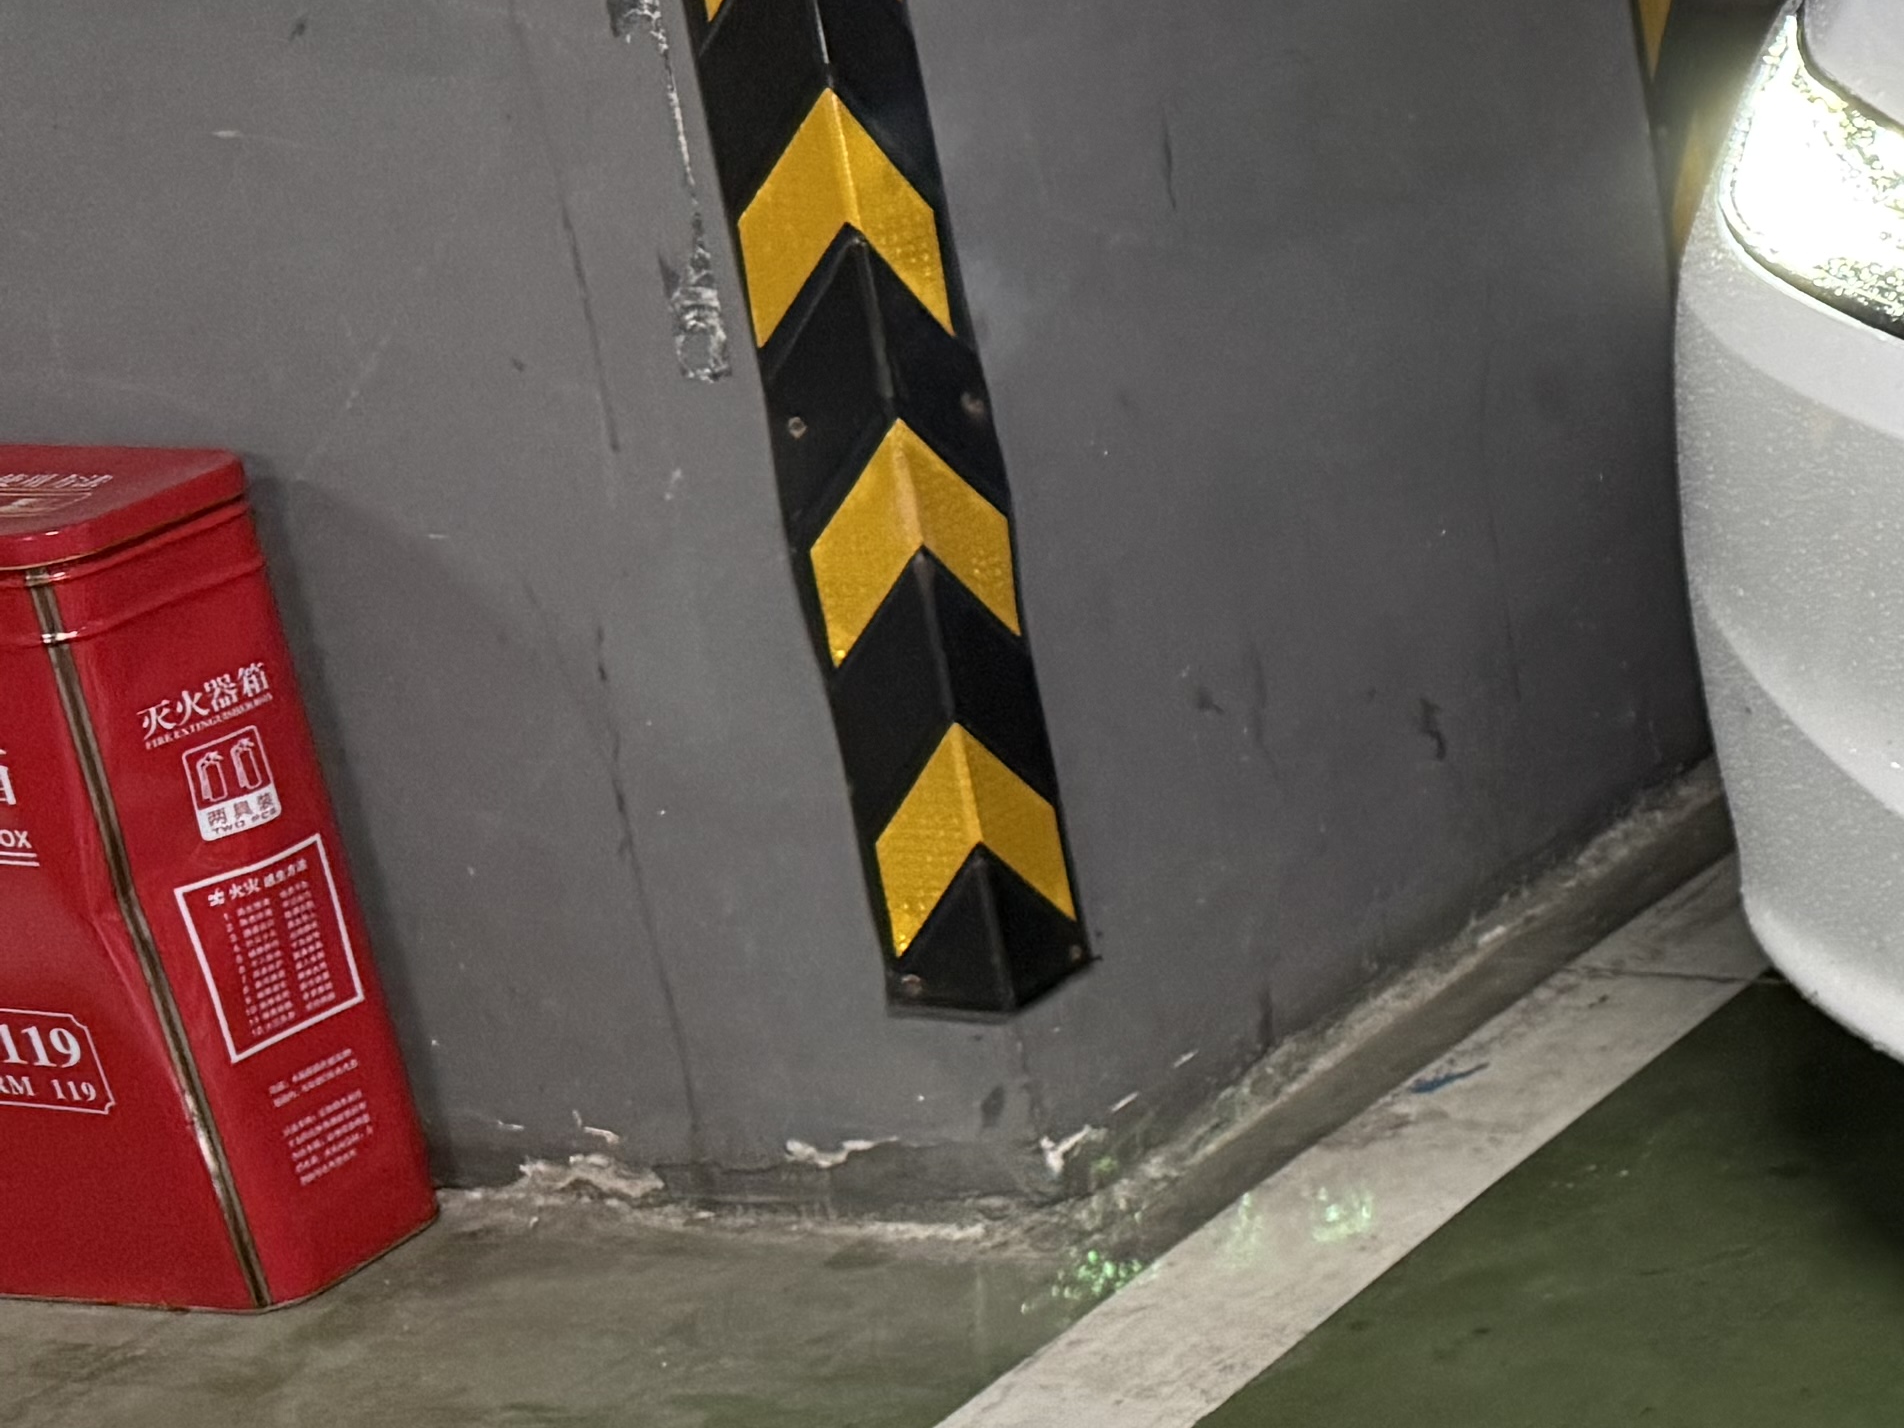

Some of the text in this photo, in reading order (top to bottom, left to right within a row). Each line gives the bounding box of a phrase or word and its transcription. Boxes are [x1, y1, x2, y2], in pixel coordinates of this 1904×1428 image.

[137, 662, 269, 741] 灭火器箱
[51, 1079, 97, 1101] 119
